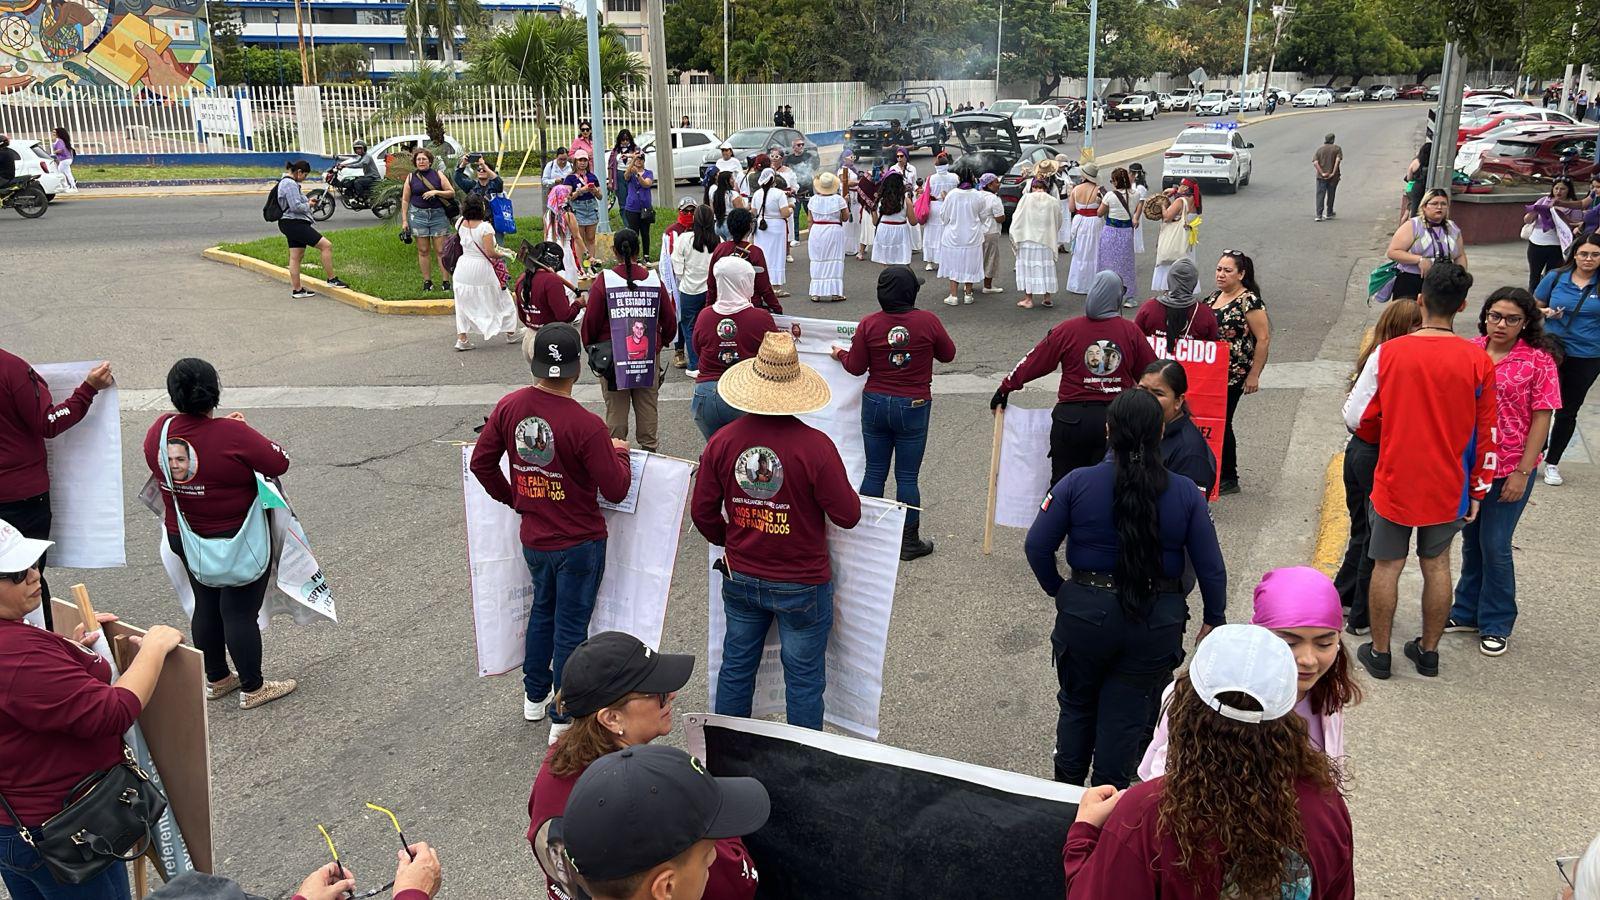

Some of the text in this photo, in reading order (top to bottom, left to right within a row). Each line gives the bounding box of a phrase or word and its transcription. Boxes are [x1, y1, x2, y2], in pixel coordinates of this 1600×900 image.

[625, 298, 645, 306] ESTADO
[1146, 336, 1217, 364] RCIDO
[550, 481, 562, 490] TU
[735, 507, 787, 524] NOS FALTAS TU
[765, 523, 790, 535] TODOS
[311, 568, 324, 582] FU
[307, 579, 329, 604] SEPTIE
